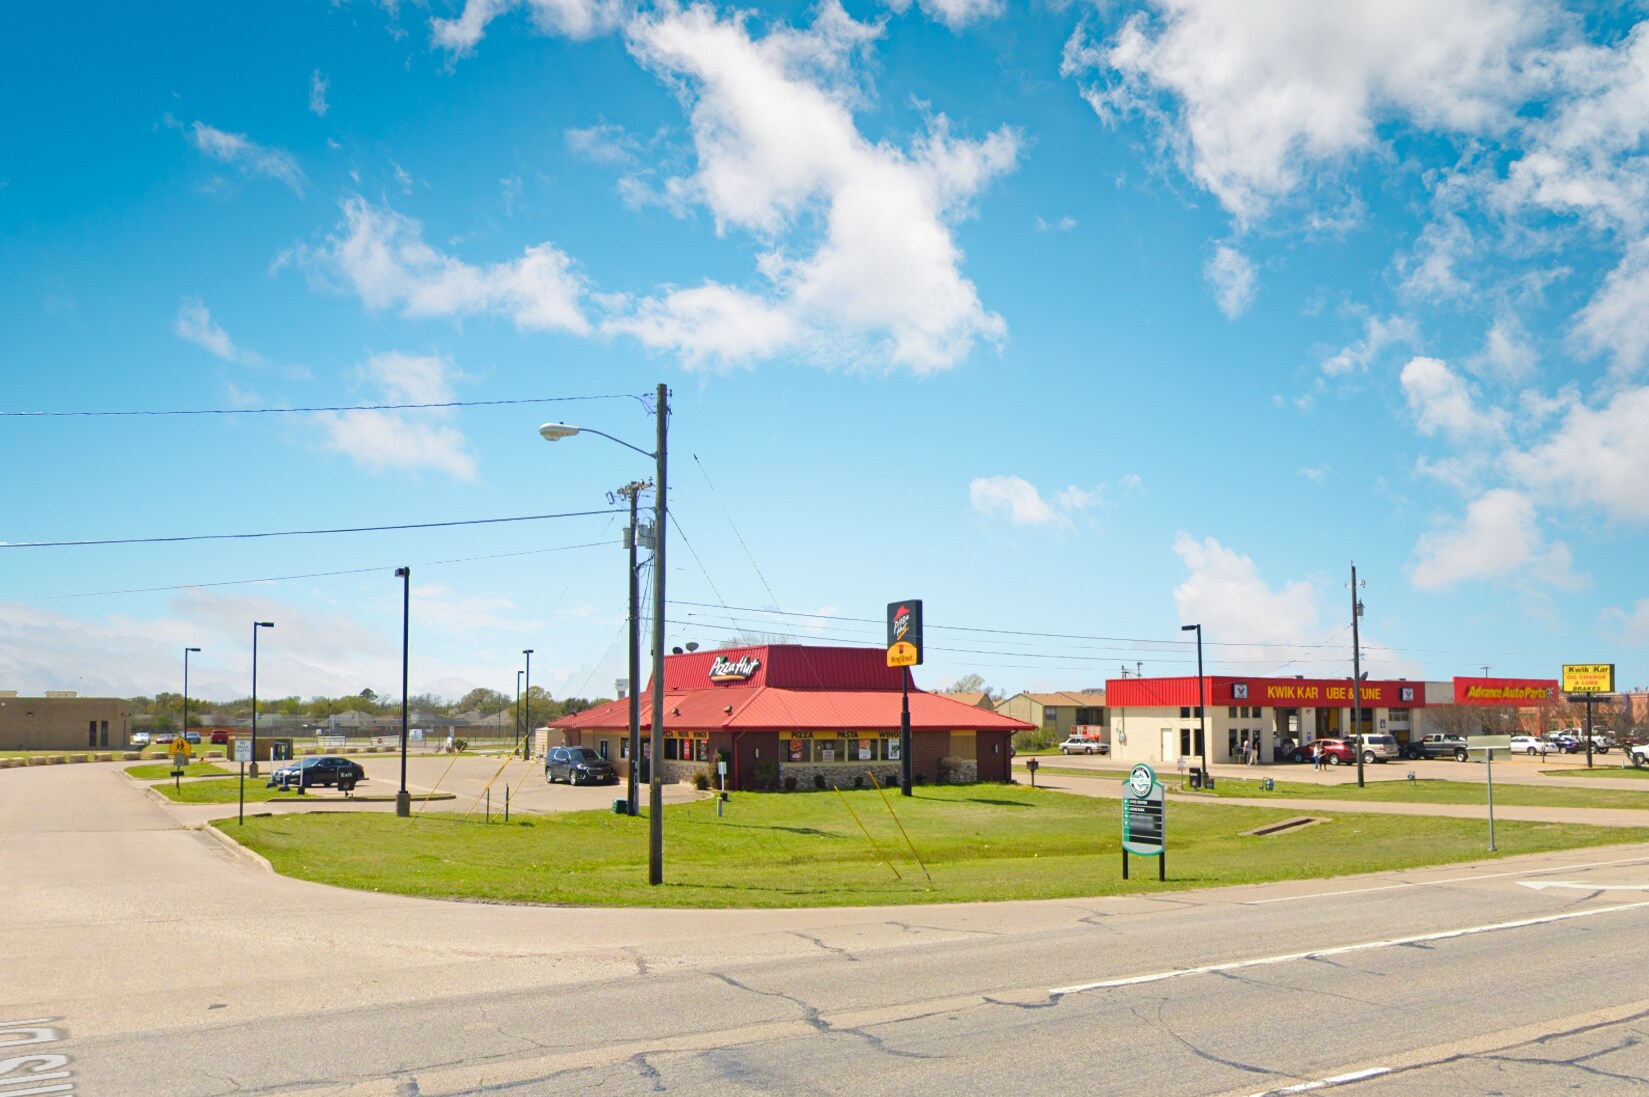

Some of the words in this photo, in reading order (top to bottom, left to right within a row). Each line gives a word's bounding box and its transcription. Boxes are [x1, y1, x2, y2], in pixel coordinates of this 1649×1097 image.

[893, 614, 910, 635] Pizza
[896, 622, 909, 637] Hut
[708, 656, 735, 676] Pizza
[735, 656, 760, 675] Hut
[891, 655, 913, 665] WingStreet
[1268, 686, 1295, 698] KWIK
[1297, 686, 1318, 699] KAR
[1347, 687, 1355, 699] &
[1467, 686, 1502, 698] Advance
[1502, 687, 1524, 698] Auto
[1524, 687, 1546, 699] Parts
